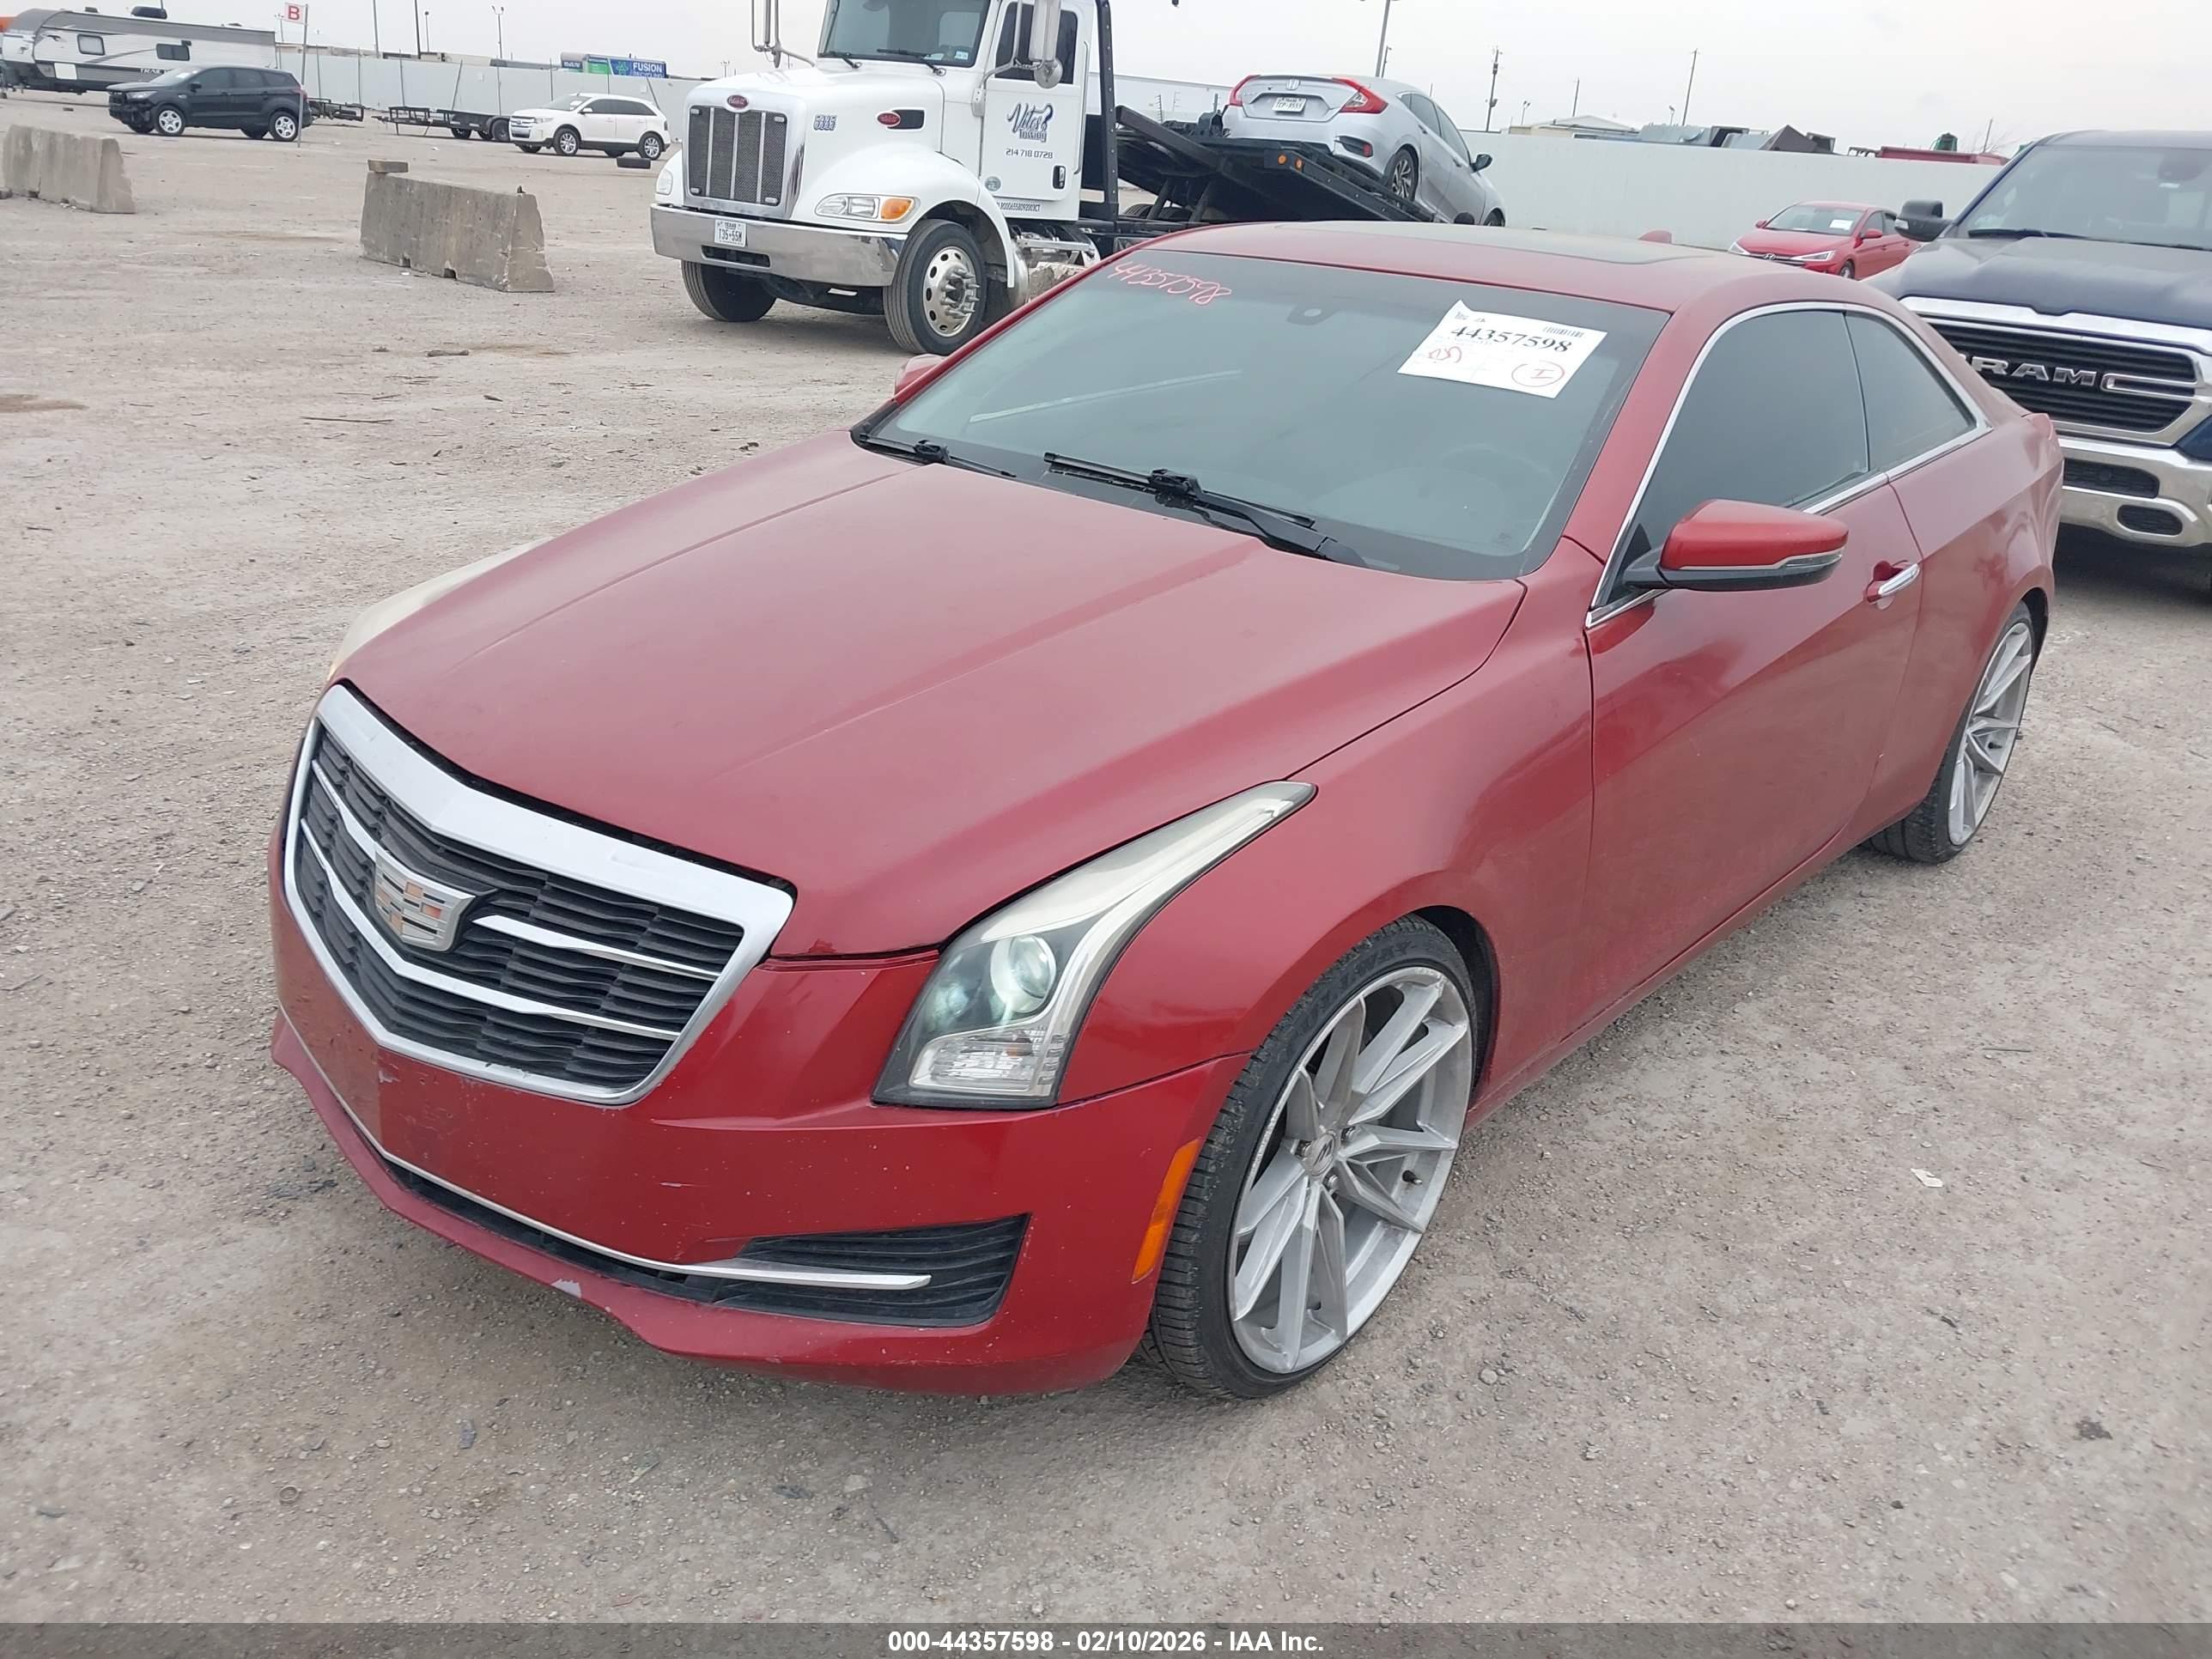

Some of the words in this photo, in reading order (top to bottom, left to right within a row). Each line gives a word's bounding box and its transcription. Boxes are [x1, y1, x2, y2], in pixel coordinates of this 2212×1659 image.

[289, 5, 300, 21] B
[633, 61, 663, 72] FUSION
[1006, 148, 1018, 156] 214
[1107, 260, 1233, 305] 44357598
[1450, 325, 1572, 353] 44357598
[1972, 356, 2098, 386] RAM
